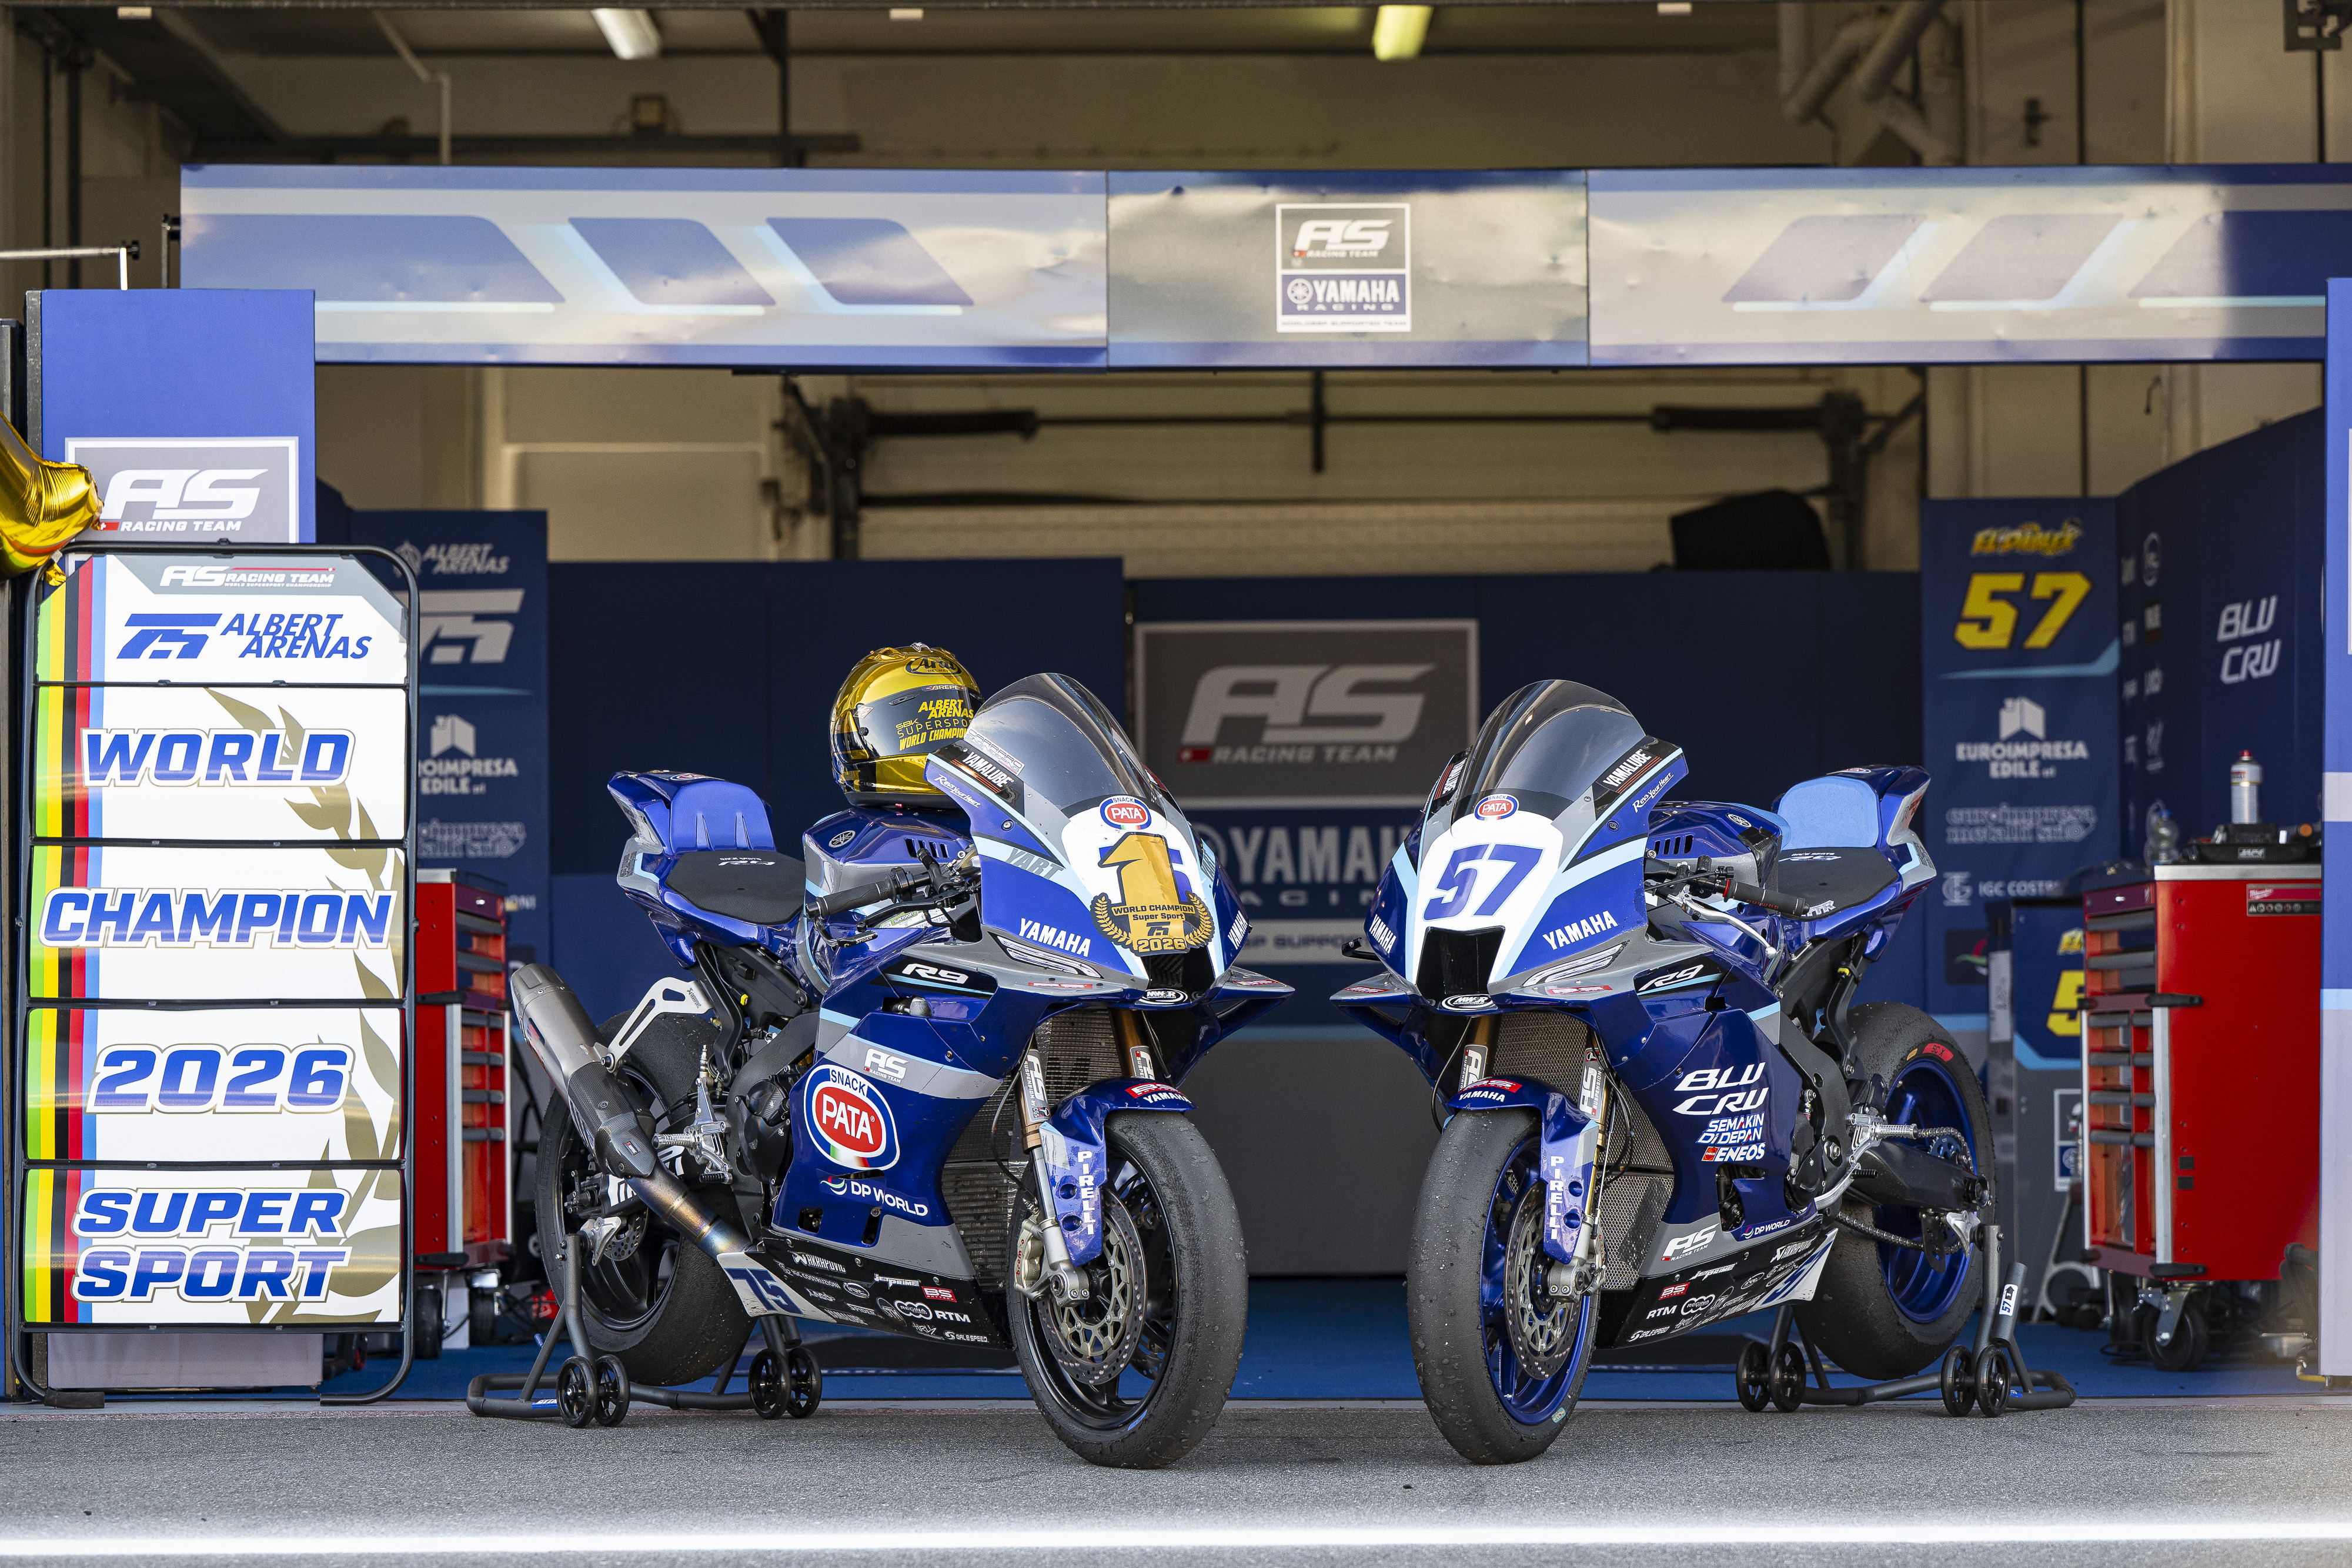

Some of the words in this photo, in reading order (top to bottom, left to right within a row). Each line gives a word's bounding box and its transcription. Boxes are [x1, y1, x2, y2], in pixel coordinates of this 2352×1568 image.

[1294, 219, 1393, 250] AS
[1307, 250, 1347, 258] RACING
[1349, 250, 1379, 258] TEAM
[1312, 280, 1401, 303] YAMAHA
[101, 469, 269, 520] AS
[121, 521, 190, 531] RACING
[193, 520, 242, 531] TEAM
[160, 566, 232, 587] AS
[226, 573, 286, 583] RACING
[290, 574, 335, 583] TEAM
[1953, 571, 2093, 651] 57
[2217, 594, 2278, 643] BLU
[116, 613, 222, 658] 75
[220, 614, 343, 638] ALBERT
[238, 636, 372, 658] ARENAS
[2220, 639, 2282, 684] CRU
[918, 699, 964, 713] ALBERT
[927, 707, 974, 720] ARENAS
[1180, 664, 1436, 744] AS
[896, 718, 918, 729] SBK
[899, 731, 927, 751] WORLD
[1956, 741, 2089, 761] EUROIMPRESA
[83, 731, 352, 784] WORLD
[1214, 745, 1312, 764] RACING
[1323, 744, 1398, 763] TEAM
[962, 751, 1013, 788] YAMALUBE
[1603, 750, 1652, 787] YAMALUBE
[1111, 807, 1144, 820] PATA
[1482, 803, 1508, 814] PATA
[1005, 847, 1065, 881] YART
[1424, 844, 1544, 921] 57
[42, 891, 394, 946] CHAMPION
[1113, 905, 1147, 915] WORLD
[1161, 912, 1185, 921] Sport
[856, 936, 873, 944] SPIDER
[1019, 918, 1091, 958] YAMAHA
[1227, 911, 1248, 950] YAMAHA
[1369, 914, 1396, 954] YAMAHA
[1542, 911, 1618, 950] YAMAHA
[1137, 938, 1186, 952] 2026
[901, 963, 969, 985] R9
[864, 1048, 909, 1078] AS
[1939, 1048, 1946, 1057] X
[90, 1047, 351, 1109] 2026
[831, 1069, 868, 1097] SNACK
[869, 1068, 887, 1081] RACING
[887, 1073, 901, 1084] TEAM
[1674, 1062, 1765, 1091] BLU
[1143, 1092, 1192, 1104] YAMAHA
[1459, 1091, 1505, 1102] YAMAHA
[1672, 1087, 1769, 1115] CRU
[822, 1094, 874, 1145] PATA
[1718, 1128, 1762, 1145] DEPAN
[1718, 1142, 1766, 1162] ENEOS
[850, 1180, 873, 1198] DP
[874, 1185, 929, 1217] WORLD
[1077, 1150, 1094, 1235] PIRELLI
[1549, 1155, 1565, 1240] PIRELLI
[75, 1191, 348, 1235] SUPER
[1754, 1226, 1765, 1235] DP
[1766, 1219, 1790, 1232] WORLD
[1663, 1222, 1720, 1257] AS
[1671, 1249, 1693, 1262] RACING
[1693, 1243, 1709, 1253] TEAM
[75, 1249, 348, 1299] SPORT
[801, 1273, 841, 1289] COSTRUZIONI
[724, 1267, 804, 1315] 75
[923, 1288, 953, 1298] BS
[1662, 1283, 1688, 1296] BS
[900, 1305, 927, 1314] REGINA
[934, 1310, 971, 1323] RTM
[1646, 1305, 1678, 1319] RTM
[2001, 1300, 2012, 1313] 57
